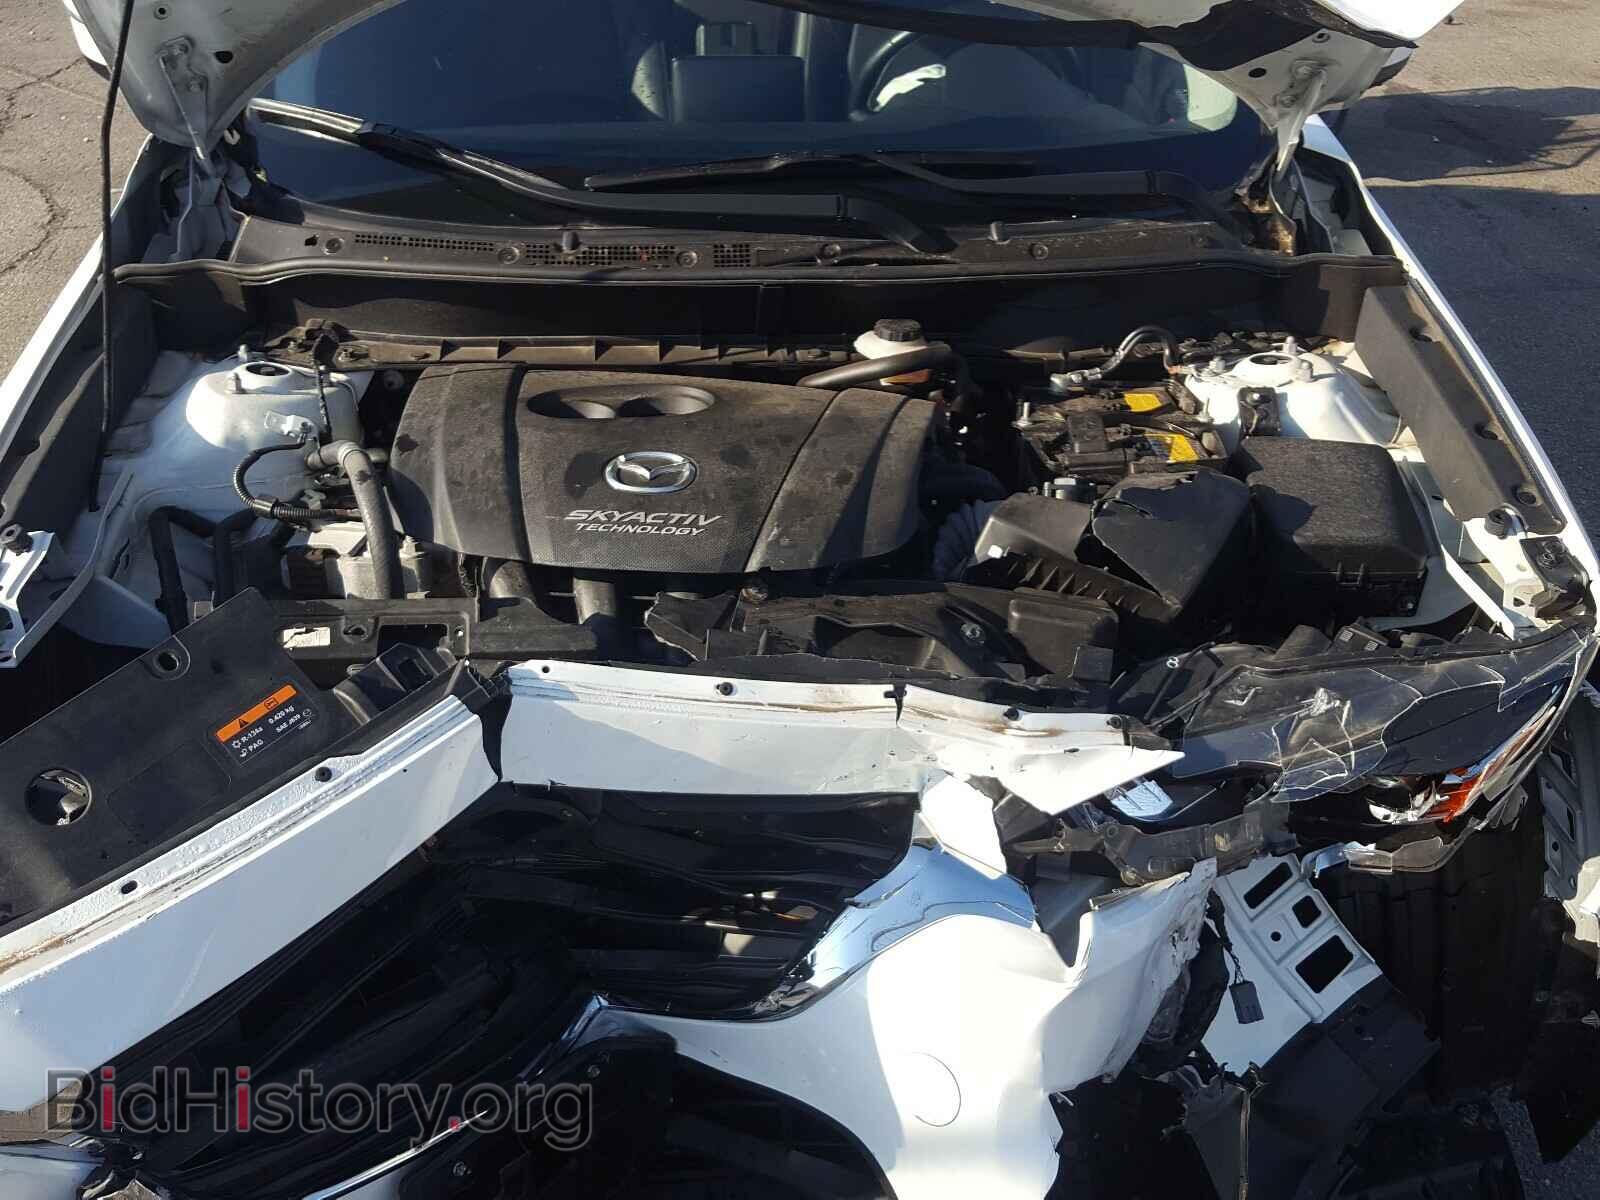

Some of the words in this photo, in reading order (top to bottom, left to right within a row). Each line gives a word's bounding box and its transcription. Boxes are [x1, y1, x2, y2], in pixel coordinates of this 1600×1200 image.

[563, 509, 723, 526] SKYACTIV
[575, 523, 705, 536] TECHNOLOGY
[248, 738, 264, 752] PAG
